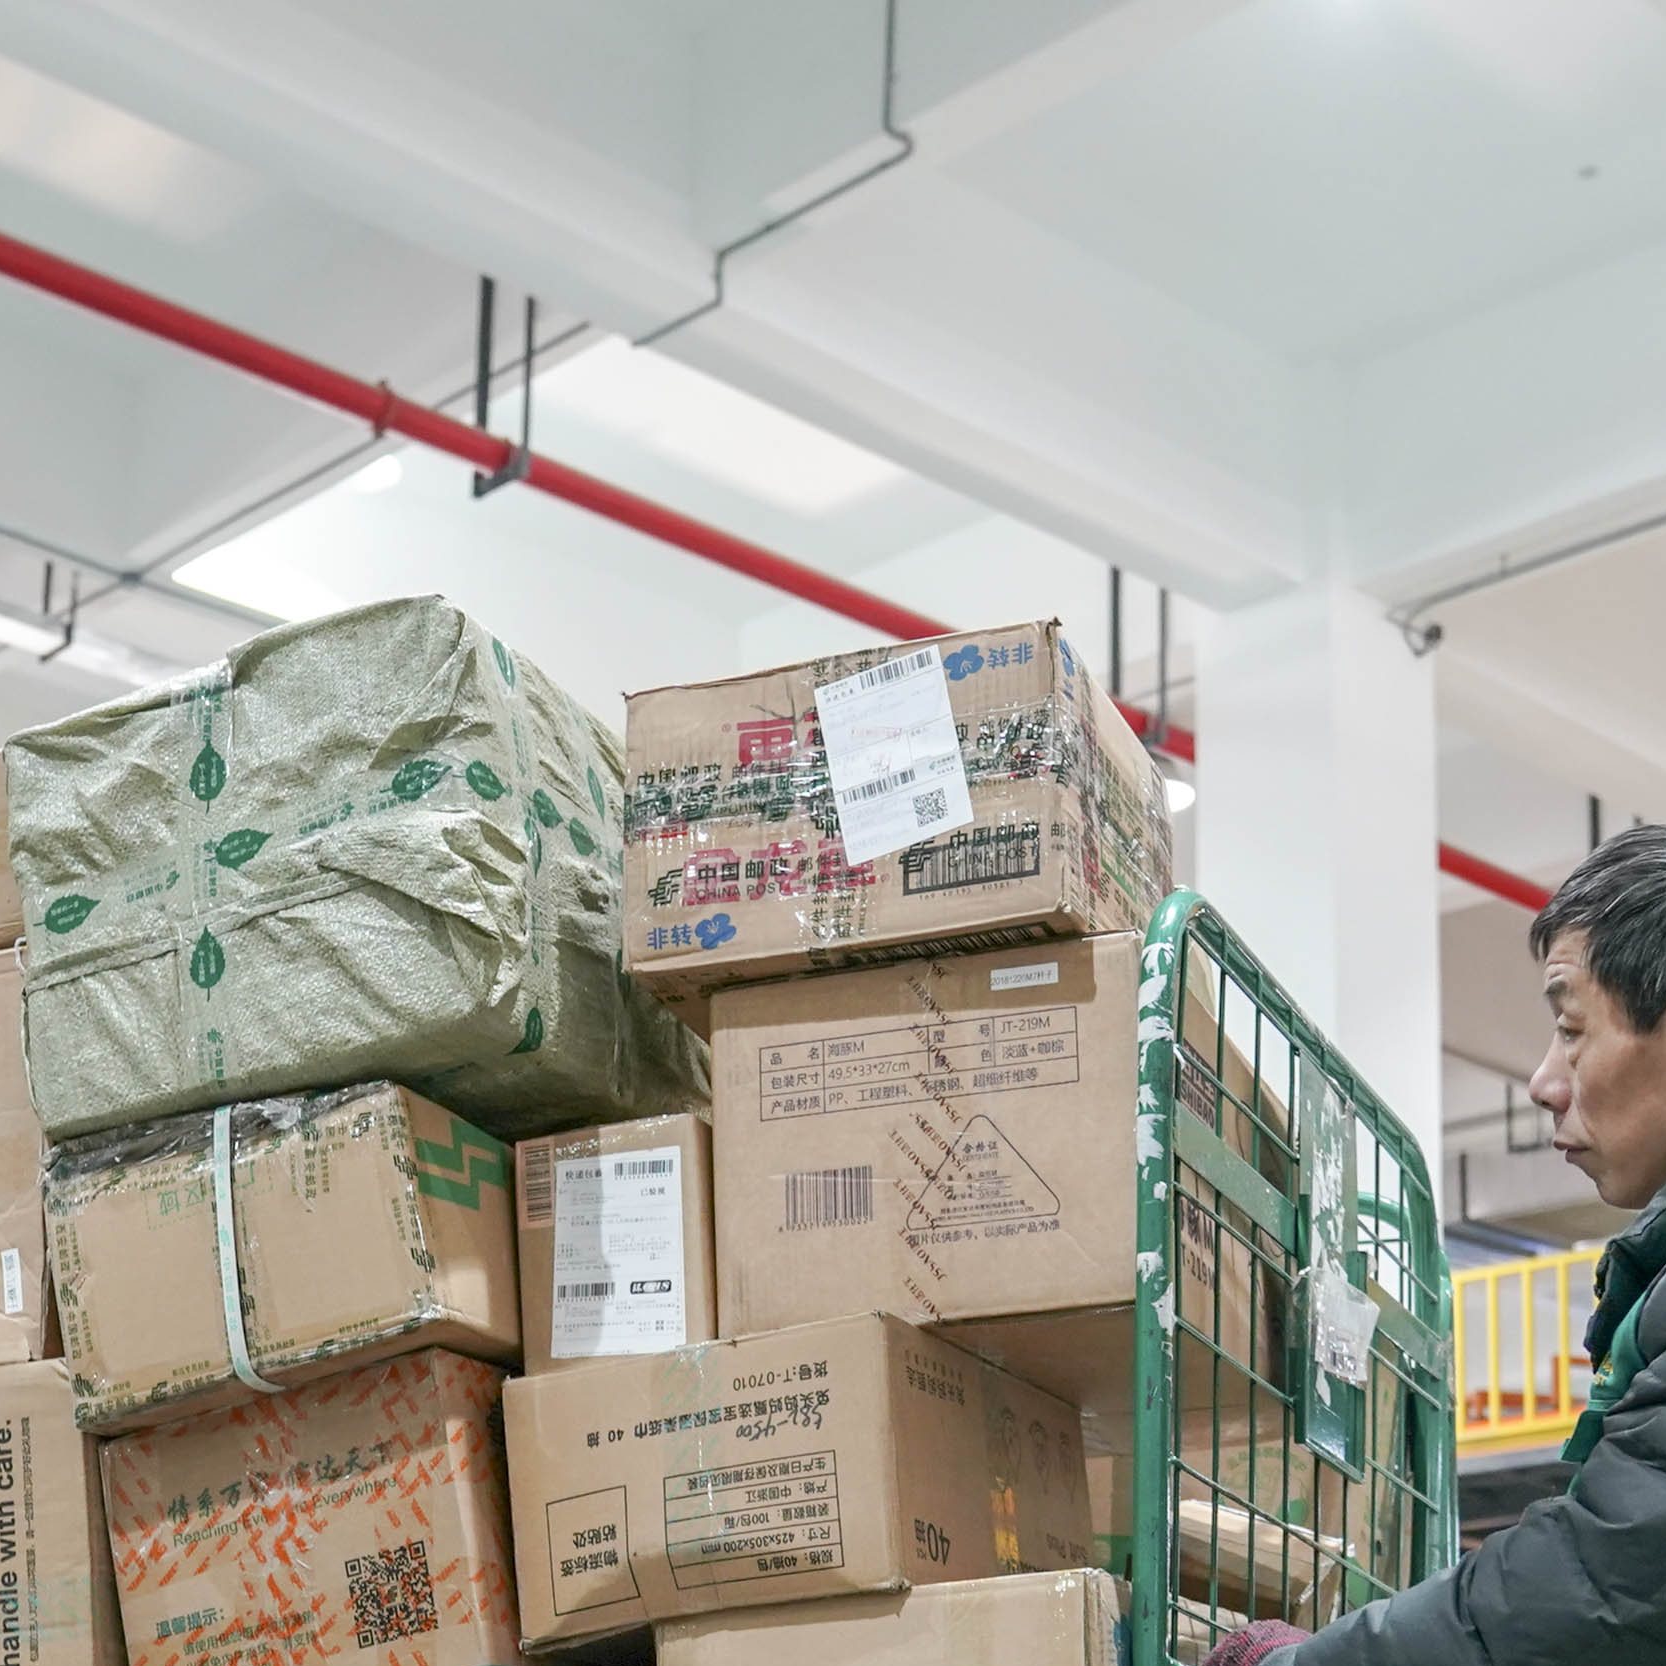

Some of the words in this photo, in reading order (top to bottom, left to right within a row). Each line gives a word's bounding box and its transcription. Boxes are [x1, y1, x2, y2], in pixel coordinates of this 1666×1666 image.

[698, 857, 788, 883] 中国邮政
[1001, 1016, 1051, 1034] JT-219M
[770, 1071, 821, 1090] 包装尺寸
[770, 1095, 822, 1114] 产品材质
[586, 1431, 601, 1449] 抽
[608, 1428, 625, 1443] 40
[686, 1456, 827, 1490] 生产日期及保存期限见包装
[173, 1519, 239, 1547] Reaching
[311, 1476, 398, 1512] Everywhere
[572, 1523, 618, 1550] 粘贴处
[927, 1523, 950, 1566] 40
[700, 1542, 722, 1556] mm
[559, 1550, 619, 1577] 物流标签
